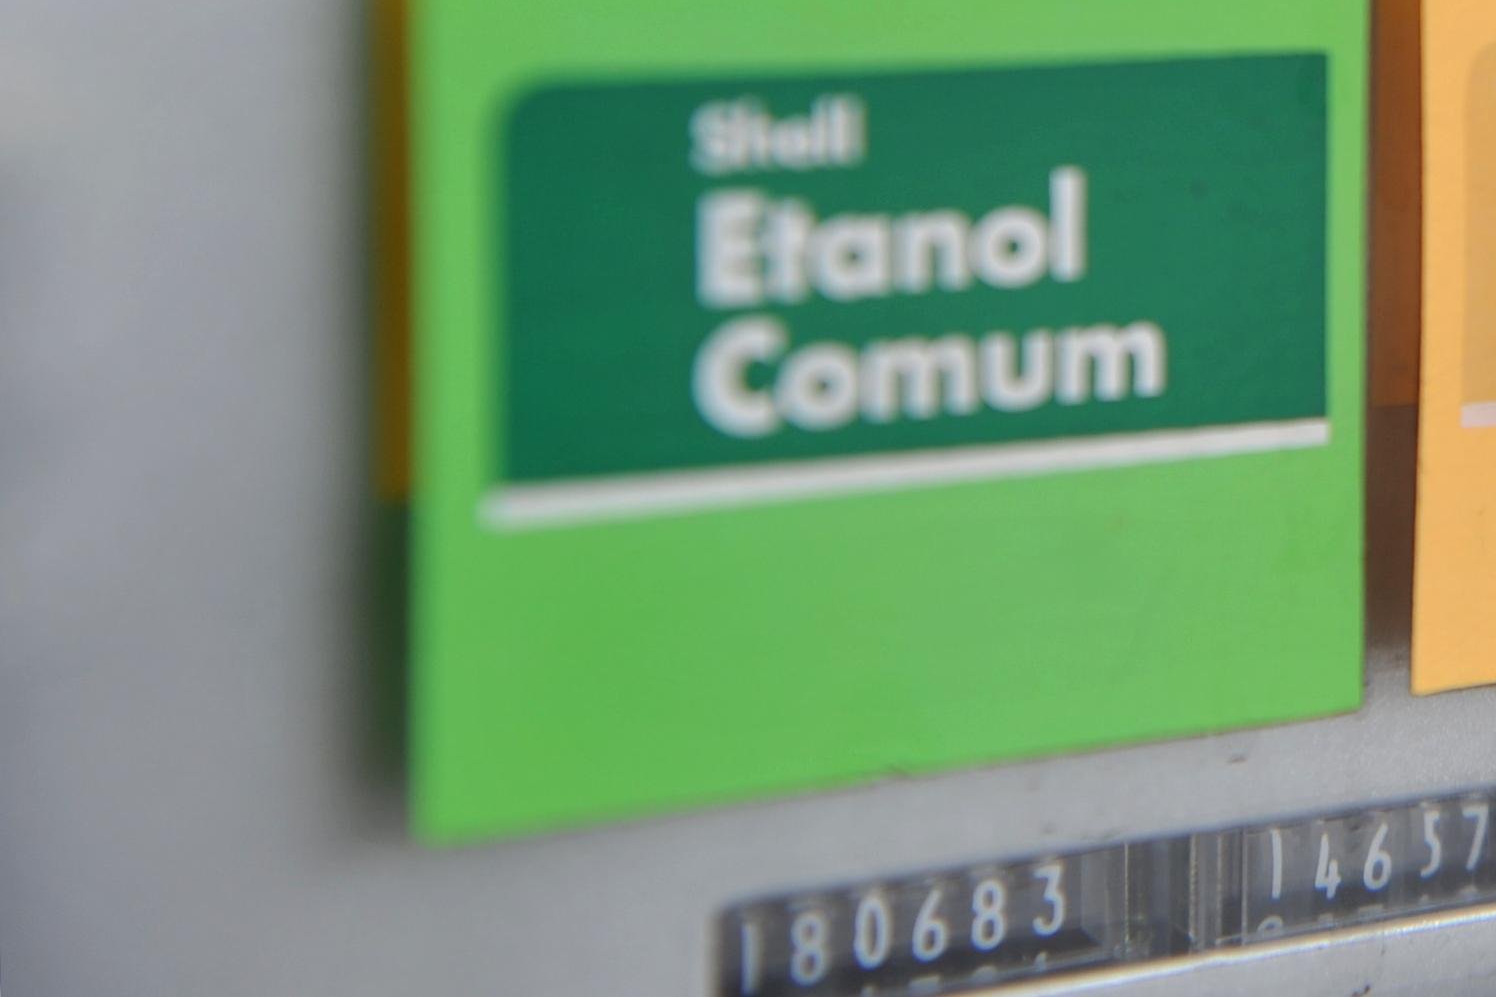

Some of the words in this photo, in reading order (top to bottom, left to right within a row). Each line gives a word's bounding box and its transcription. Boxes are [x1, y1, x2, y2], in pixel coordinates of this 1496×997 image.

[690, 95, 866, 174] Shell
[697, 165, 1088, 308] Etanol
[691, 314, 1167, 438] Comum
